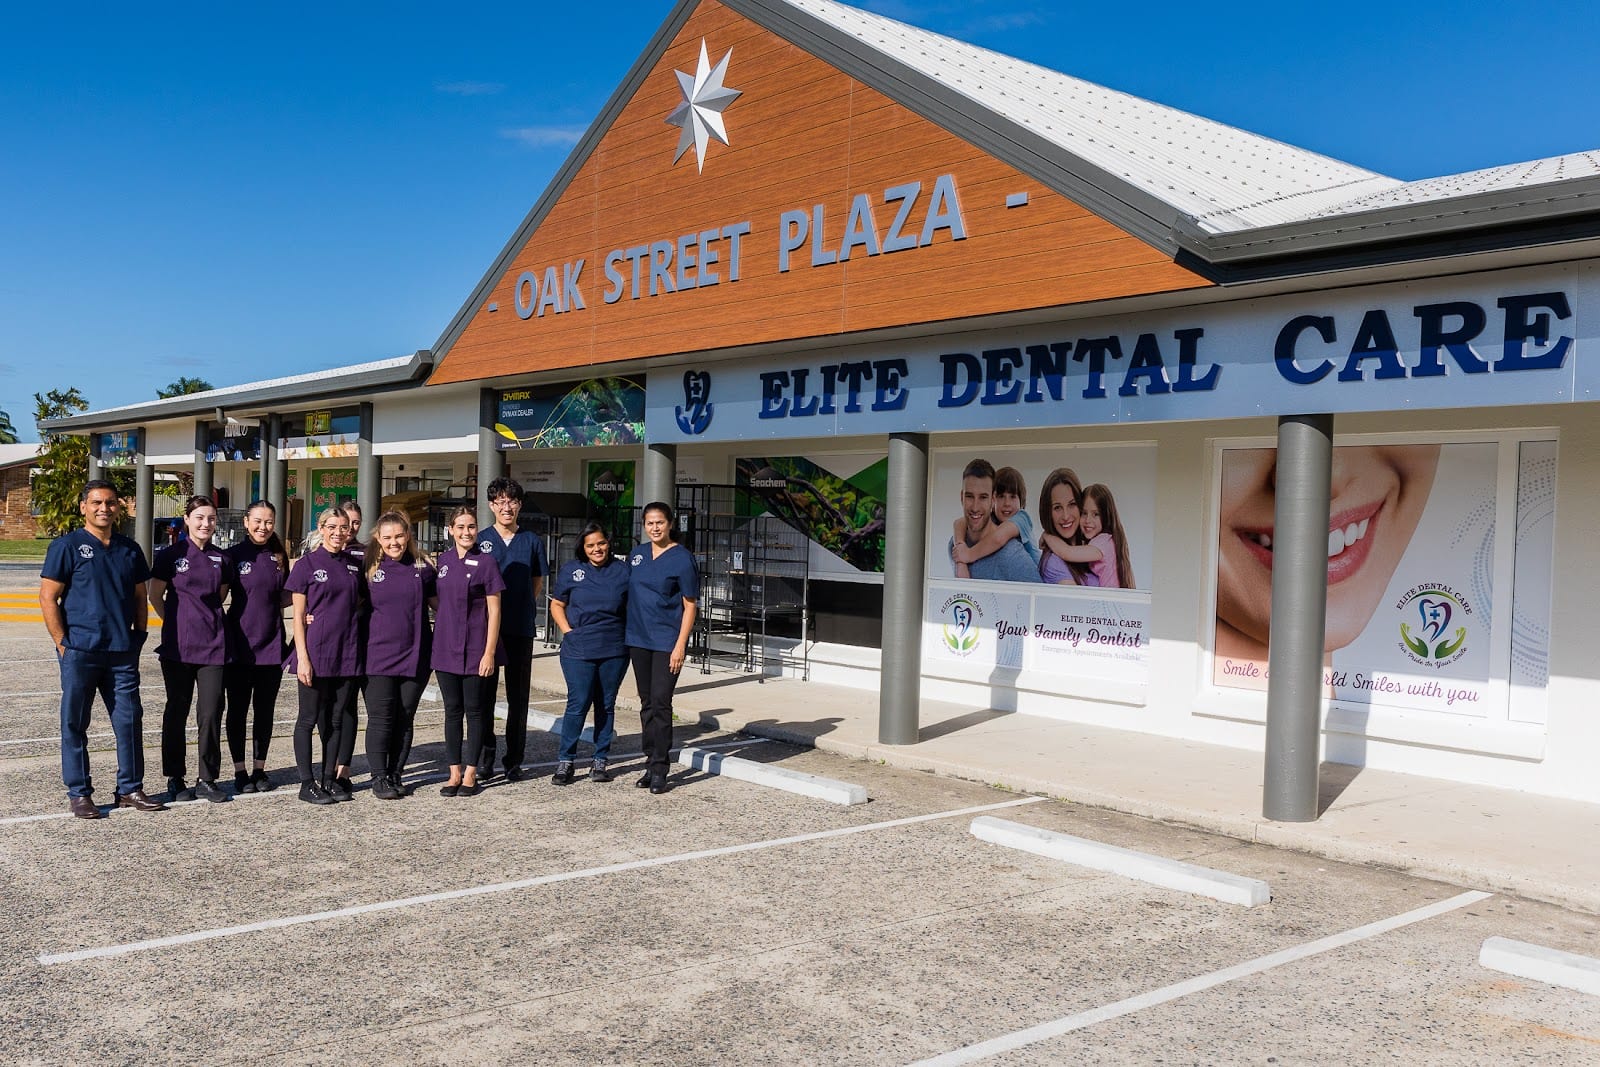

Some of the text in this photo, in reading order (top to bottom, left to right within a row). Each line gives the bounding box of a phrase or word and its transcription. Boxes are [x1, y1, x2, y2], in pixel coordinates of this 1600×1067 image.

[514, 259, 586, 321] OAK
[603, 220, 752, 304] STREET
[778, 174, 967, 273] PLAZA
[759, 291, 1575, 420] ELITE DENTAL CARE
[503, 391, 530, 401] DYMAX
[593, 481, 625, 491] Seachm
[750, 477, 786, 488] Seachem
[941, 593, 984, 618] ELITE DENTAL CARE
[1396, 582, 1472, 615] ELITE DENTAL CARE
[995, 620, 1142, 648] Your Family Dentist
[1060, 614, 1143, 629] ELITE DENTAL CARE
[1407, 652, 1424, 665] Pride
[1434, 659, 1452, 669] Your
[1452, 647, 1467, 662] Smile
[1223, 659, 1260, 677] Smile
[1325, 671, 1348, 687] rld
[1352, 673, 1403, 693] Smiles
[1407, 681, 1443, 698] with
[1447, 688, 1480, 705] you
